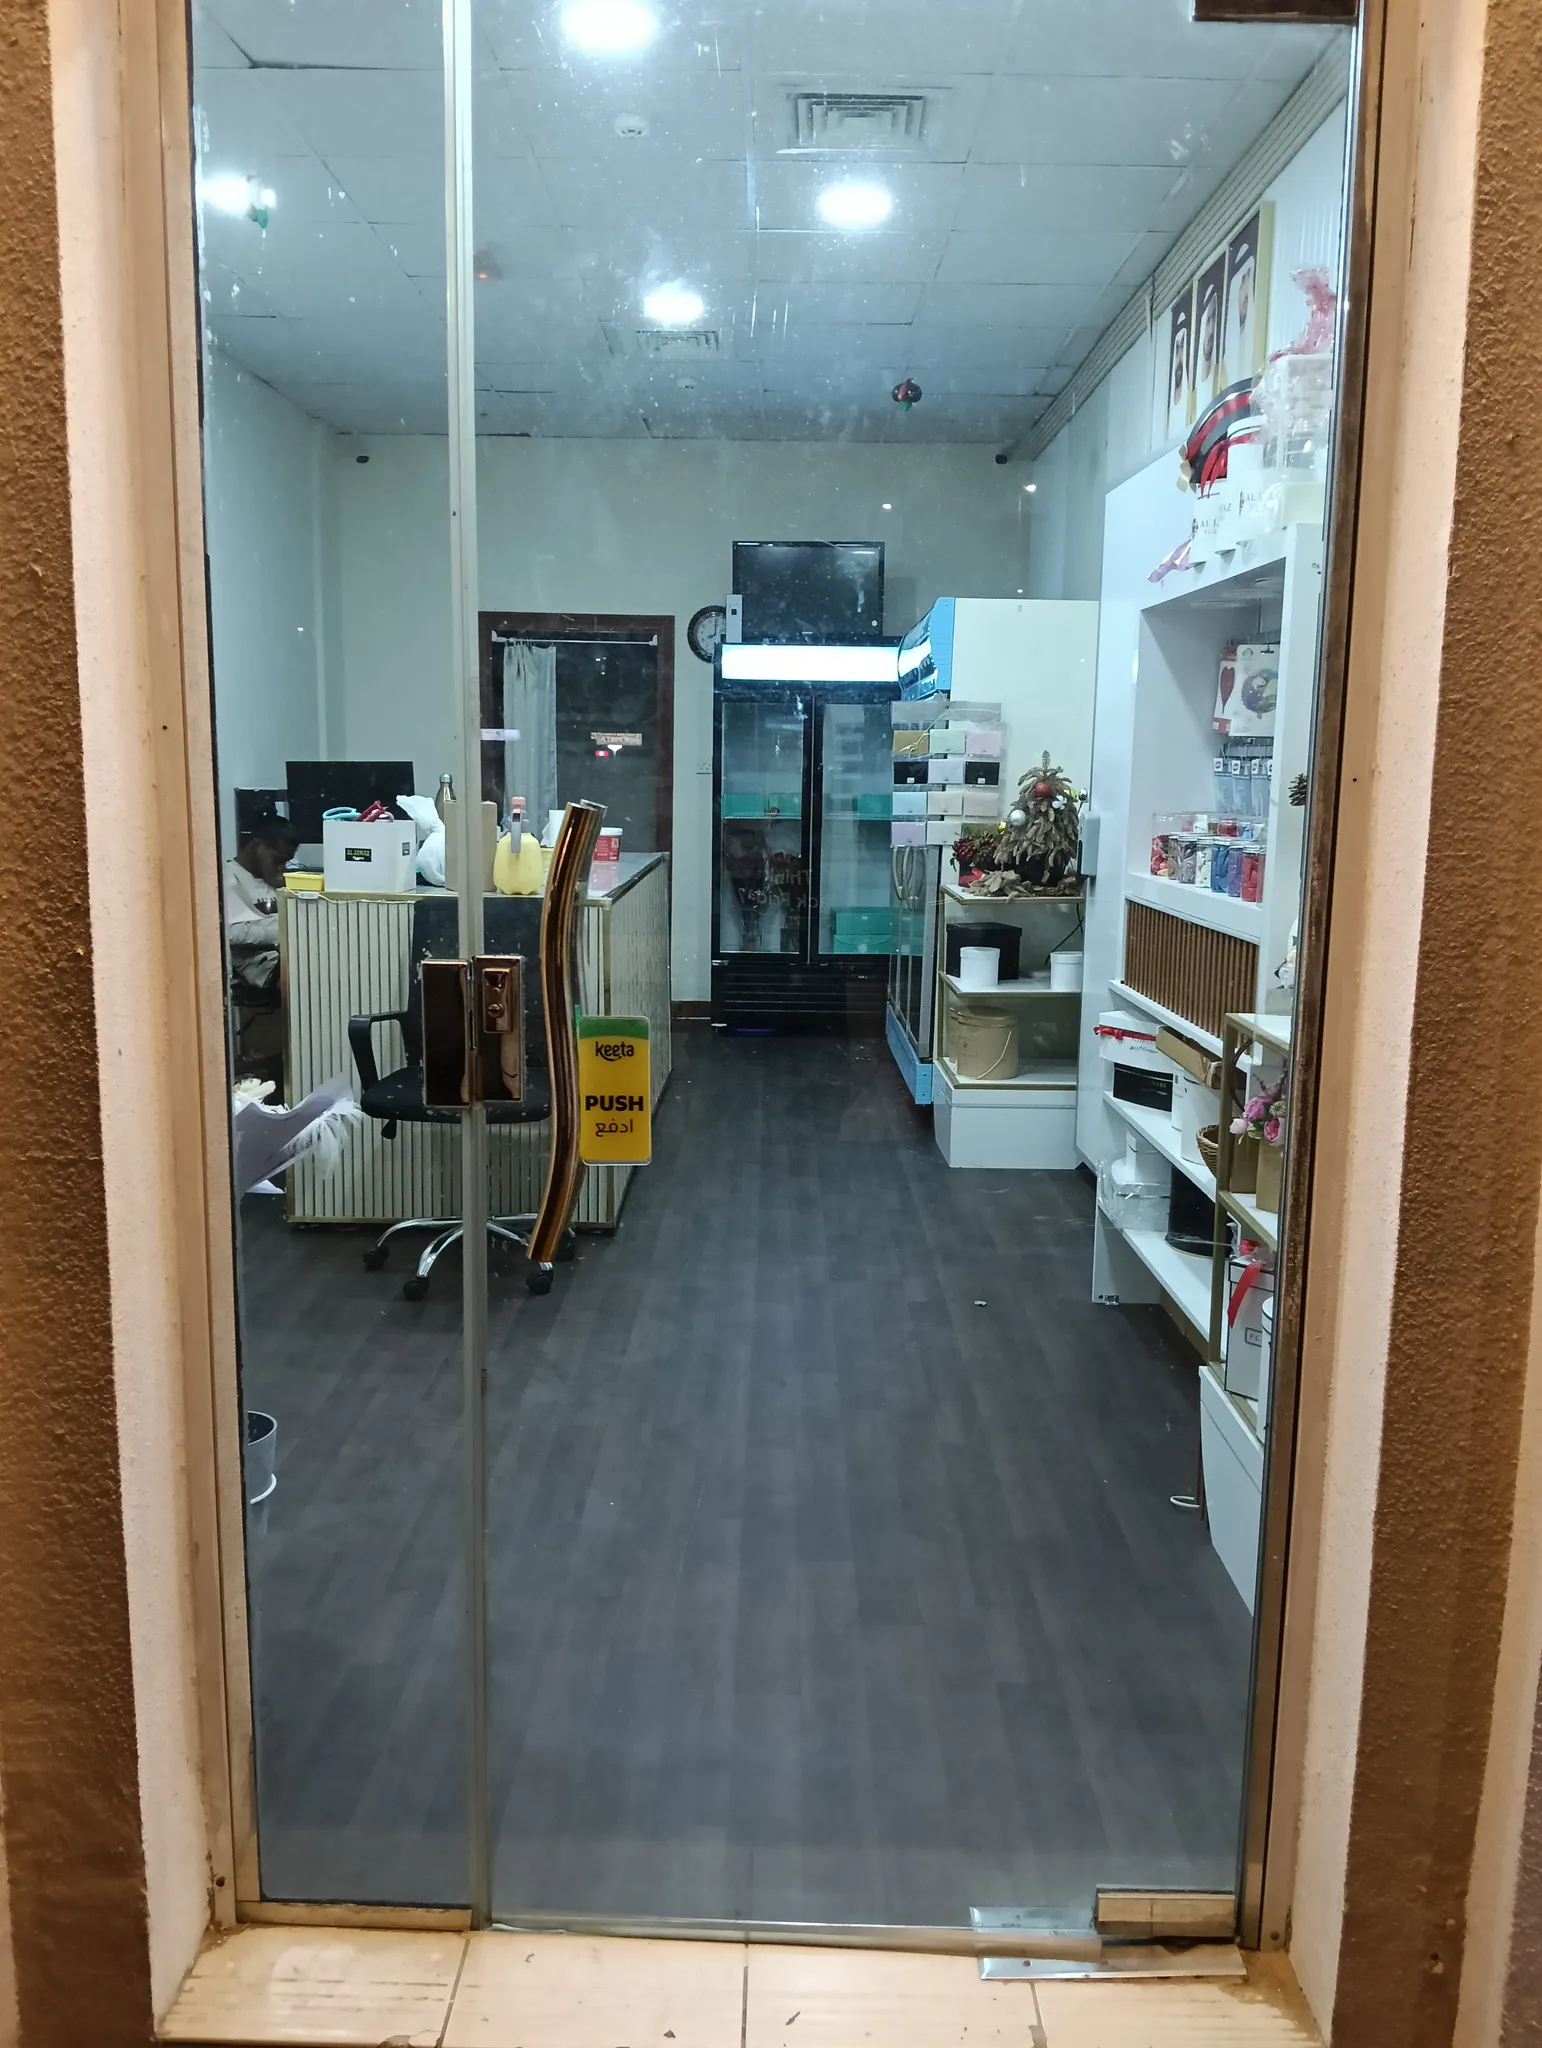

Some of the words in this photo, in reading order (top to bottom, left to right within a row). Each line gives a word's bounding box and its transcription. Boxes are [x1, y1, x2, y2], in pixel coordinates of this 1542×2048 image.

[595, 1041, 634, 1061] keeta
[585, 1095, 644, 1111] PUSH
[595, 1118, 634, 1137] ادفع
